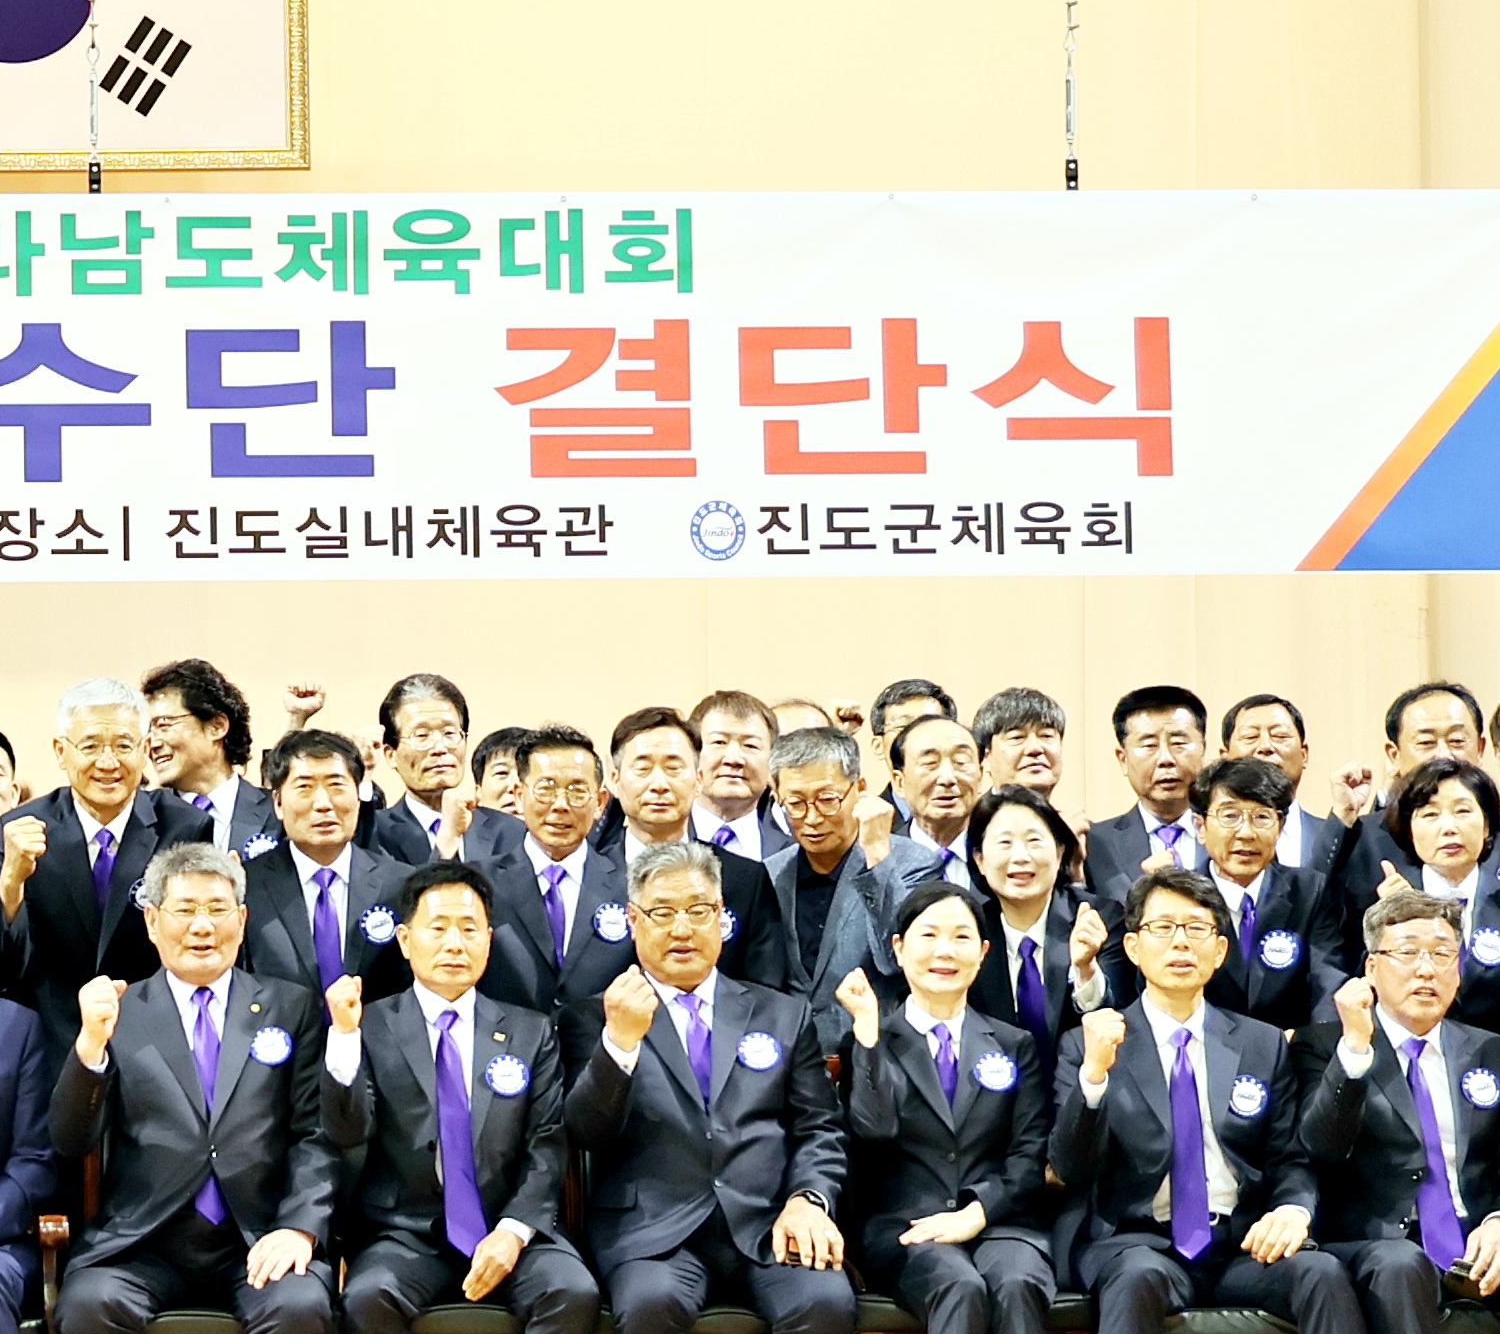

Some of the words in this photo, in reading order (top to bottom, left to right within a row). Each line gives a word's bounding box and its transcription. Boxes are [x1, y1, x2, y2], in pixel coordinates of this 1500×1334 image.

[494, 316, 1174, 478] 결단식
[166, 504, 615, 559] 진도실내체육관
[756, 500, 1133, 556] 진도군체육회
